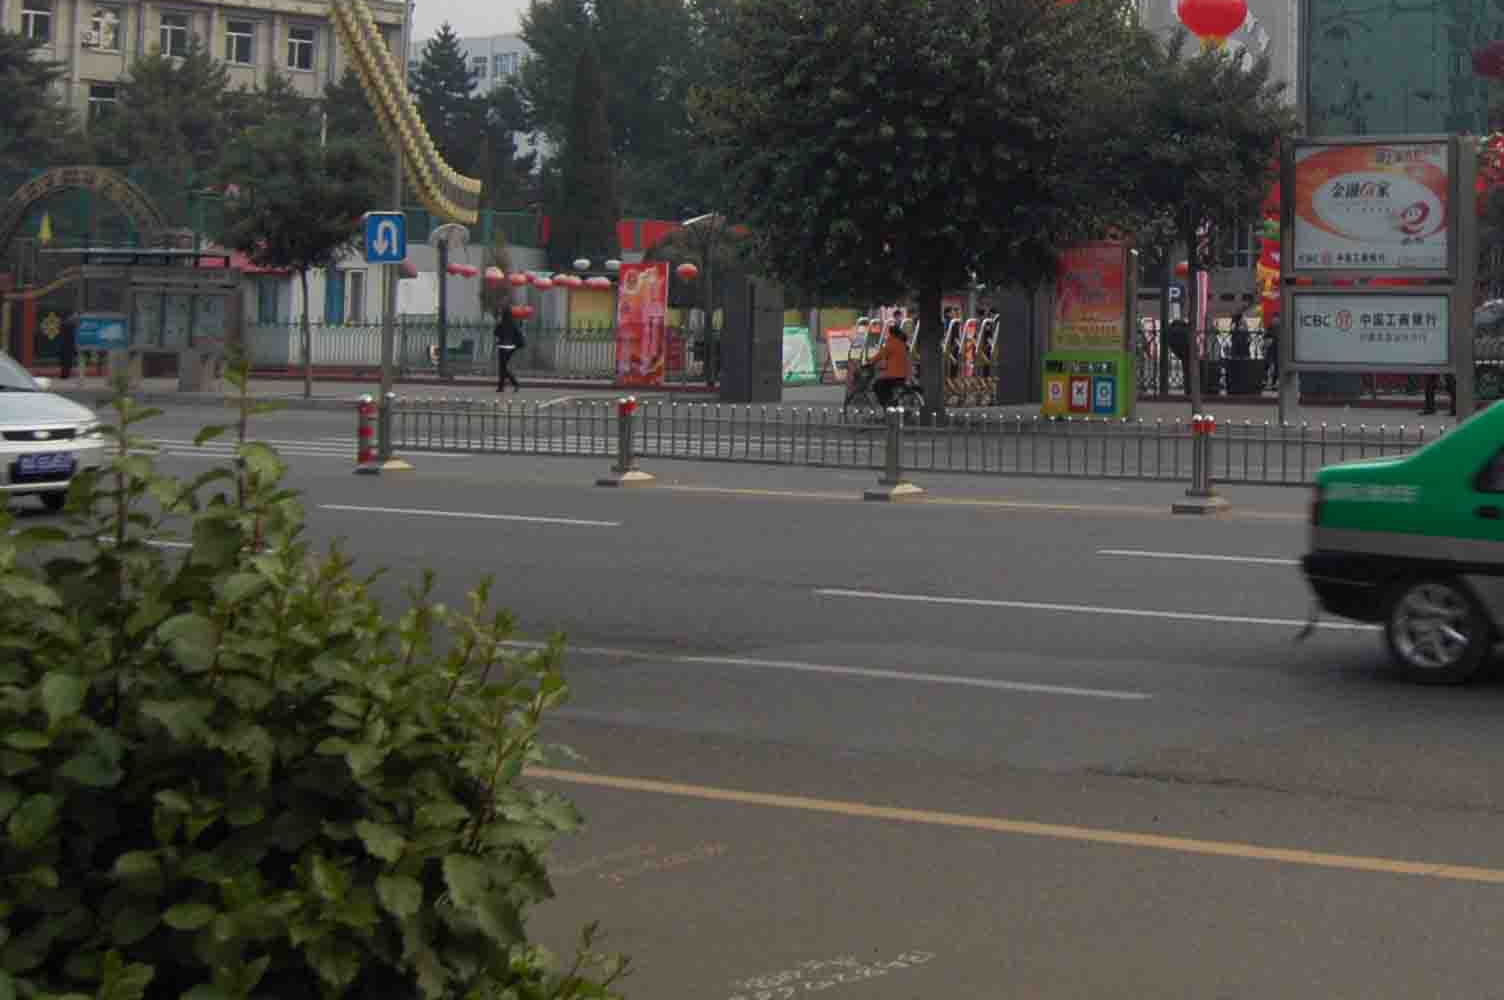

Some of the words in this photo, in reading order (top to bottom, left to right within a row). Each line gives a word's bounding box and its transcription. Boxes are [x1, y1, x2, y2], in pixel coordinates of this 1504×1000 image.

[1299, 313, 1331, 328] ICBC
[1359, 312, 1438, 329] 中国工商银行
